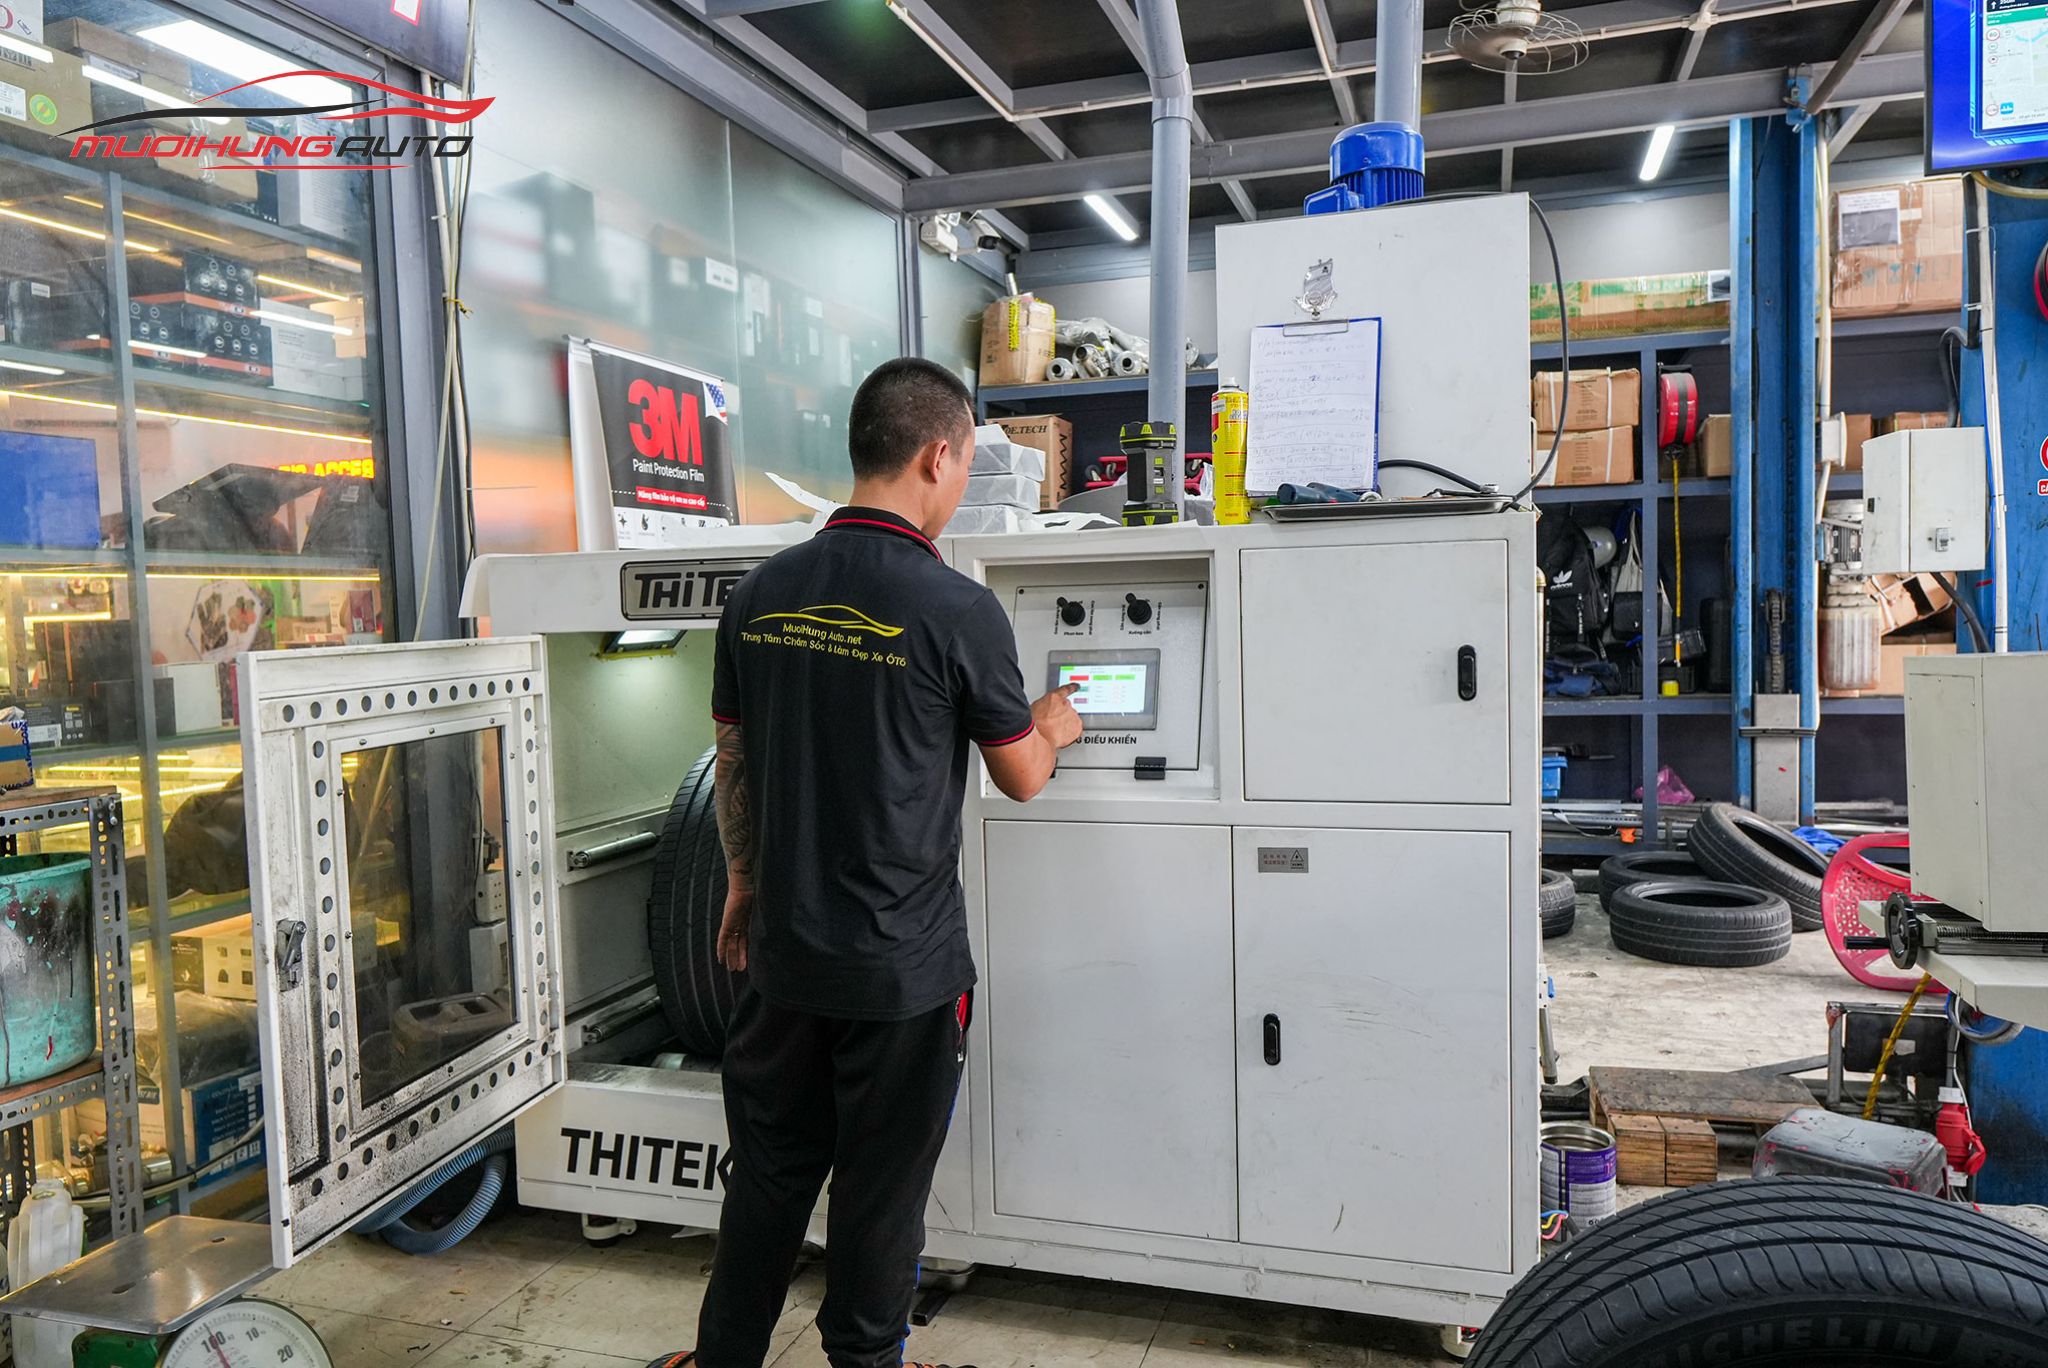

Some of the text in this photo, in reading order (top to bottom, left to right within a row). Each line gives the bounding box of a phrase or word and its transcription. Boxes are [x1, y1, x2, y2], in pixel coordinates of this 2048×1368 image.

[628, 378, 704, 465] 3M
[632, 458, 705, 482] Paint Protection Film
[741, 632, 762, 644] Trung
[871, 651, 884, 662] Xe
[245, 1327, 260, 1341] 10
[277, 1344, 294, 1363] 20
